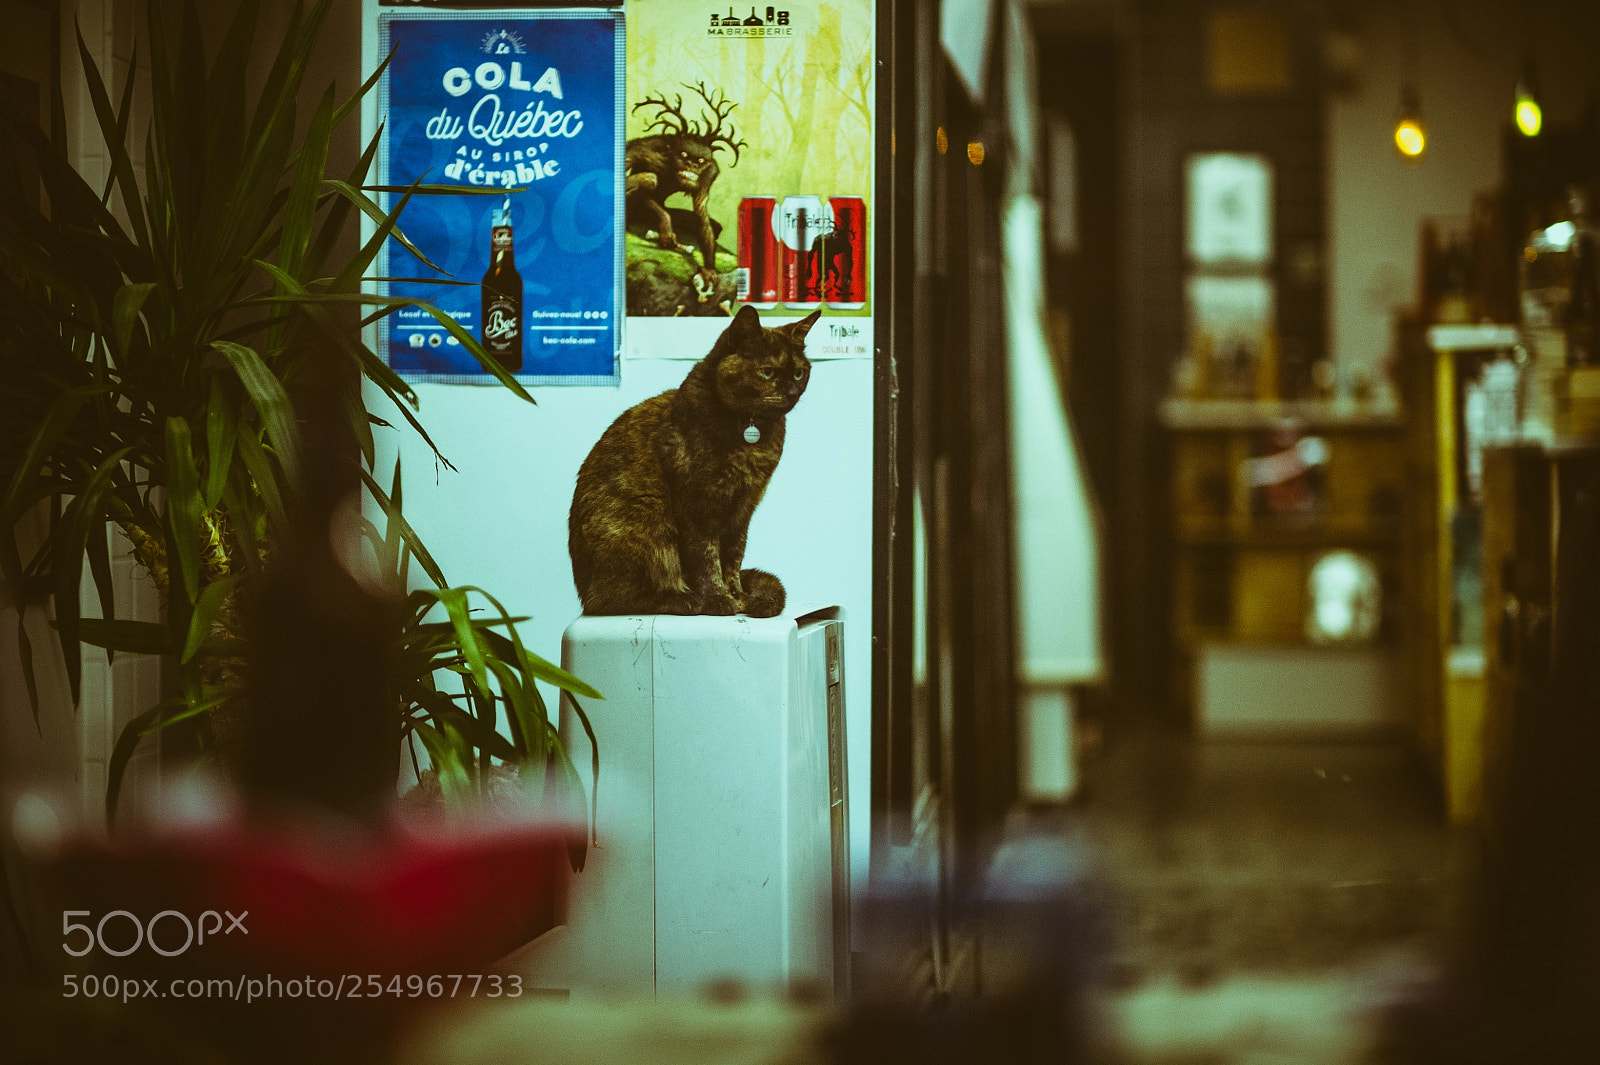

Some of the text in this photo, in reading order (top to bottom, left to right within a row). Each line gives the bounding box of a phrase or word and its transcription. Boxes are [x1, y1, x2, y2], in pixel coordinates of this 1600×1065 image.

[708, 27, 792, 35] MA BRASSERIE
[495, 41, 511, 55] Le
[442, 61, 563, 100] COLA
[425, 93, 584, 147] du Québec
[456, 142, 549, 163] AU SIROP
[444, 157, 561, 187] d'érable
[785, 212, 821, 230] Trale
[485, 310, 518, 339] Bec
[829, 324, 860, 342] Tribale
